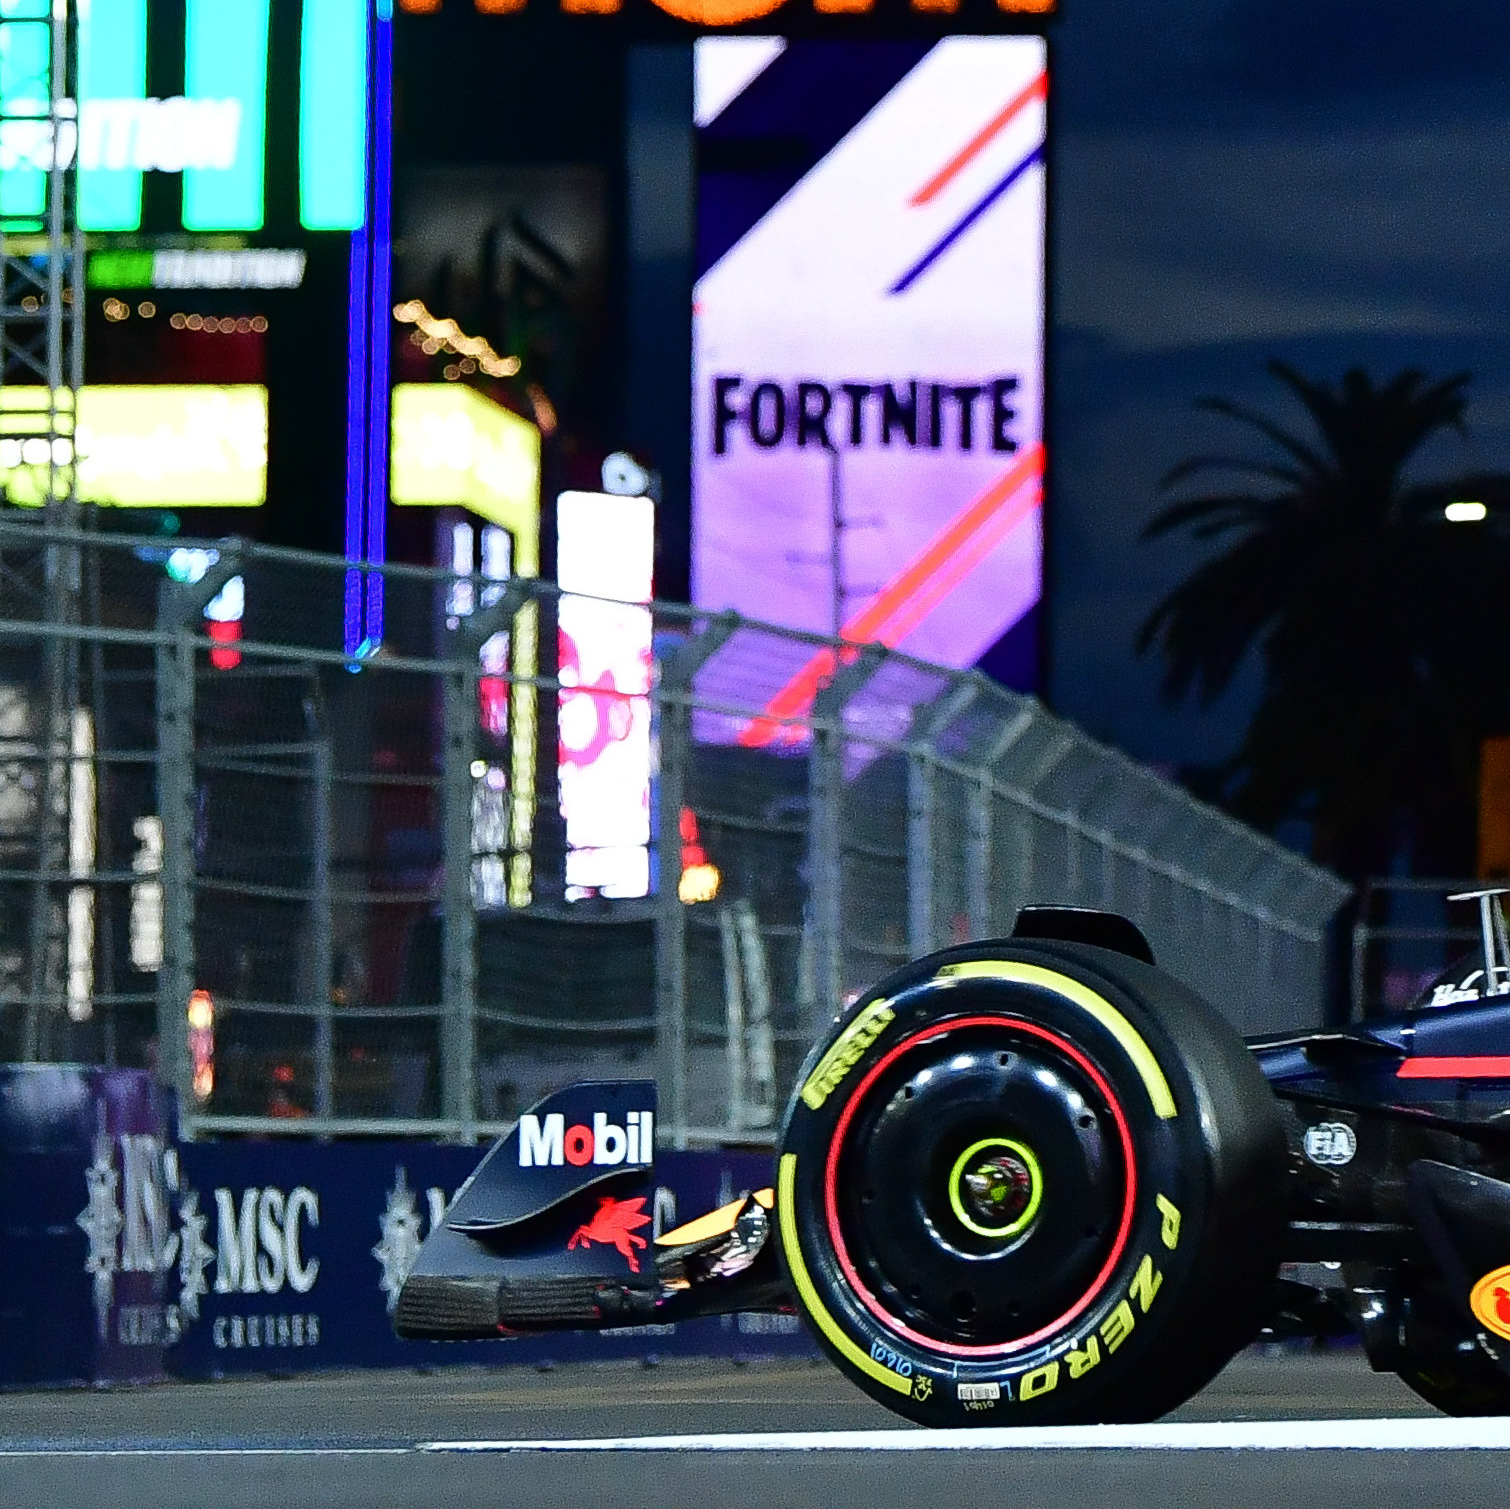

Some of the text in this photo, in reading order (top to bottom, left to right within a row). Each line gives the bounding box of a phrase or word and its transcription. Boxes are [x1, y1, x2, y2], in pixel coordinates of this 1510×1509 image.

[713, 376, 1022, 457] FORTNITE
[801, 997, 897, 1111] PIRELLI
[518, 1111, 654, 1167] Mobil
[213, 1186, 320, 1294] MSC
[1019, 1193, 1182, 1402] P ZERO
